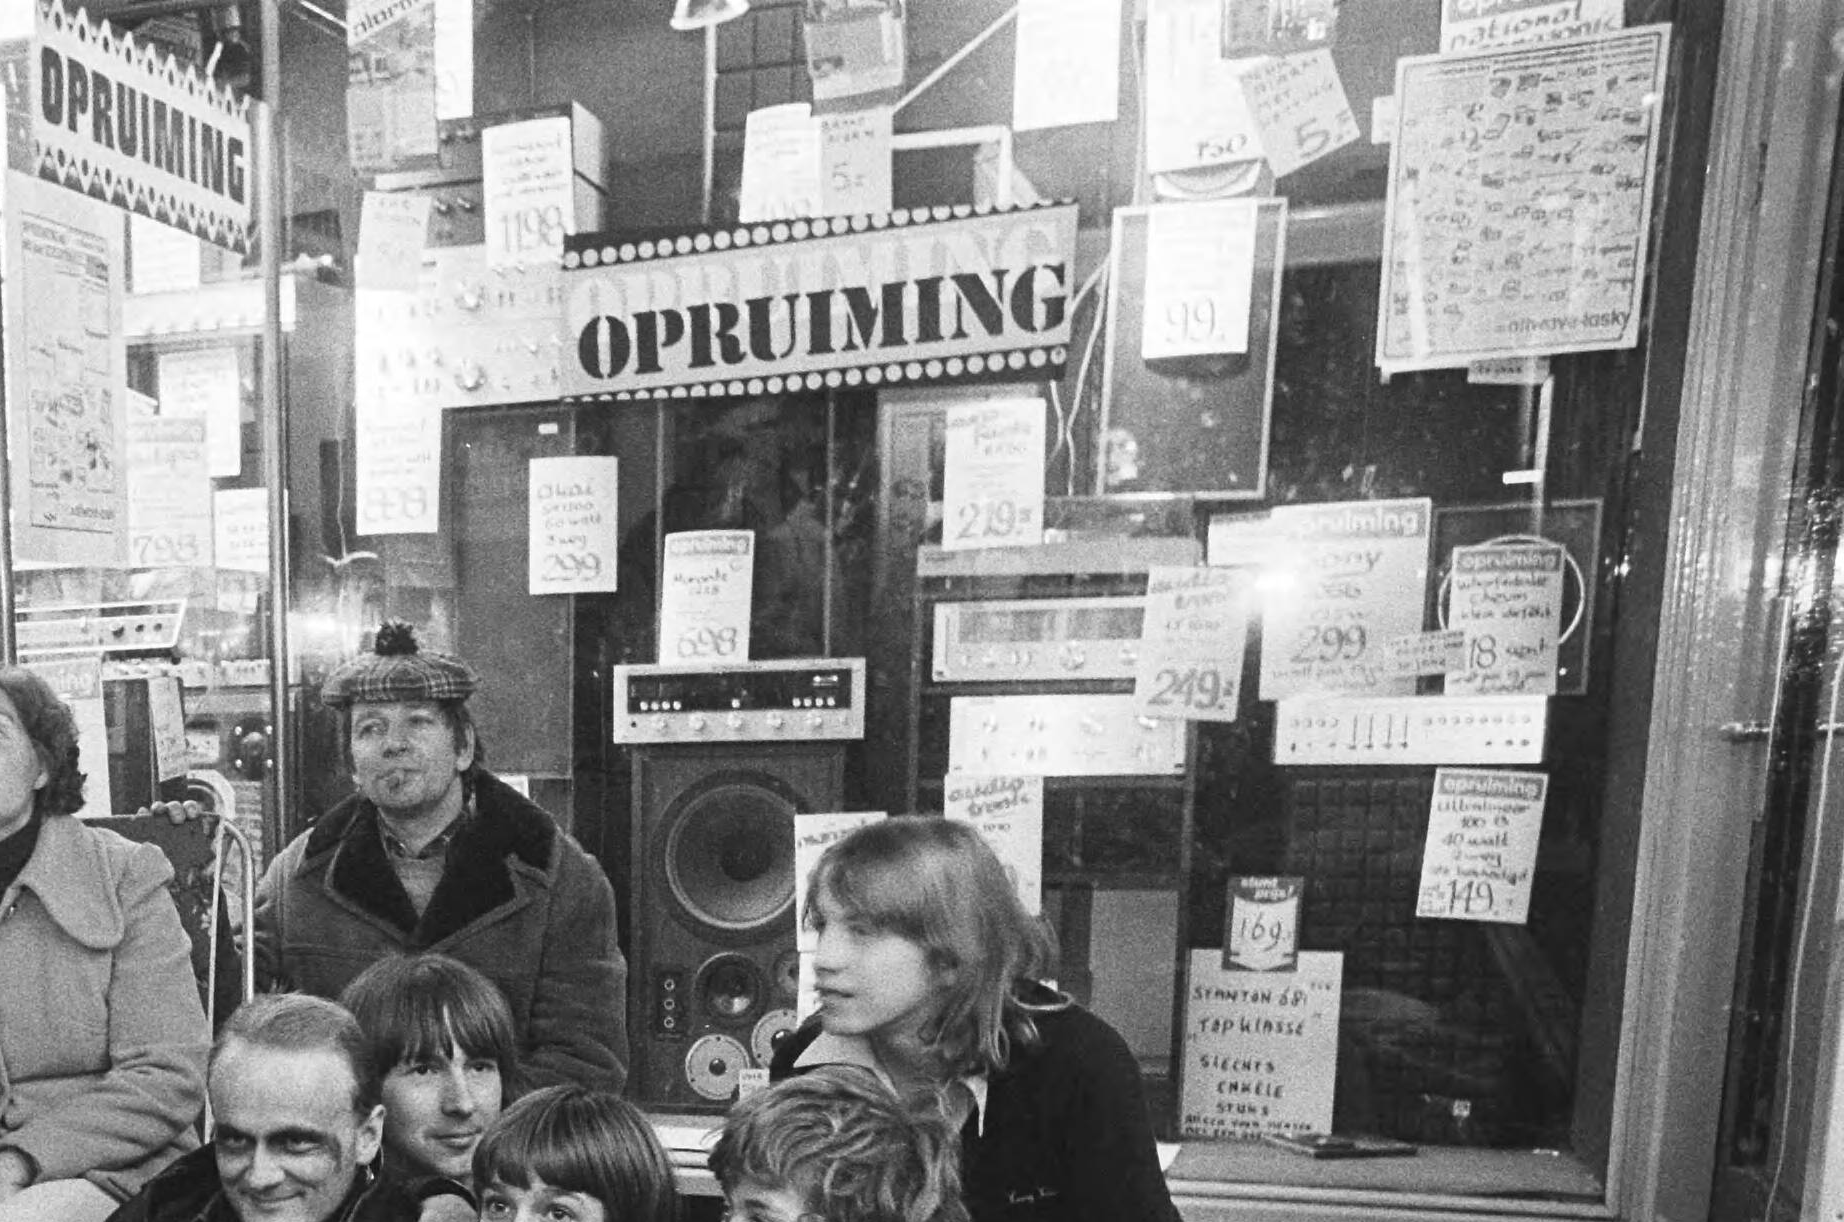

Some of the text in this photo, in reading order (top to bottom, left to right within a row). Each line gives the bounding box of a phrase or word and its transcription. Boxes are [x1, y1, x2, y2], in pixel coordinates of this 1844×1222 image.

[41, 46, 245, 205] OPRUIMING
[578, 263, 1067, 380] OPRUIMING
[1192, 984, 1272, 1005] STANTON
